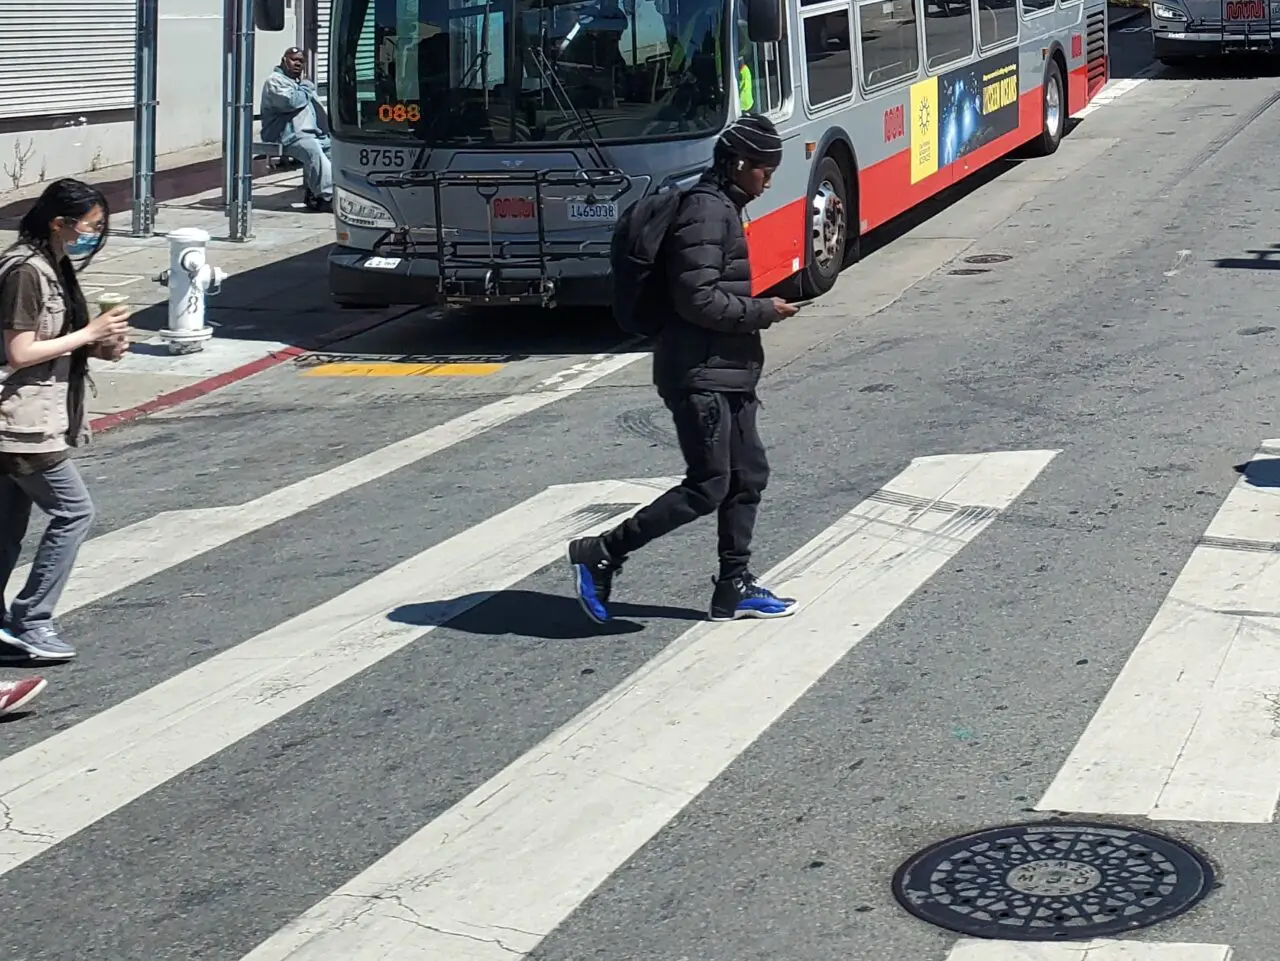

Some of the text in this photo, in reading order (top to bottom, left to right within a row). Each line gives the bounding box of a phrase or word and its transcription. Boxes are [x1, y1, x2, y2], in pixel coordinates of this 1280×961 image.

[378, 104, 421, 122] 088
[359, 149, 405, 167] 8755
[570, 204, 615, 219] 1465038
